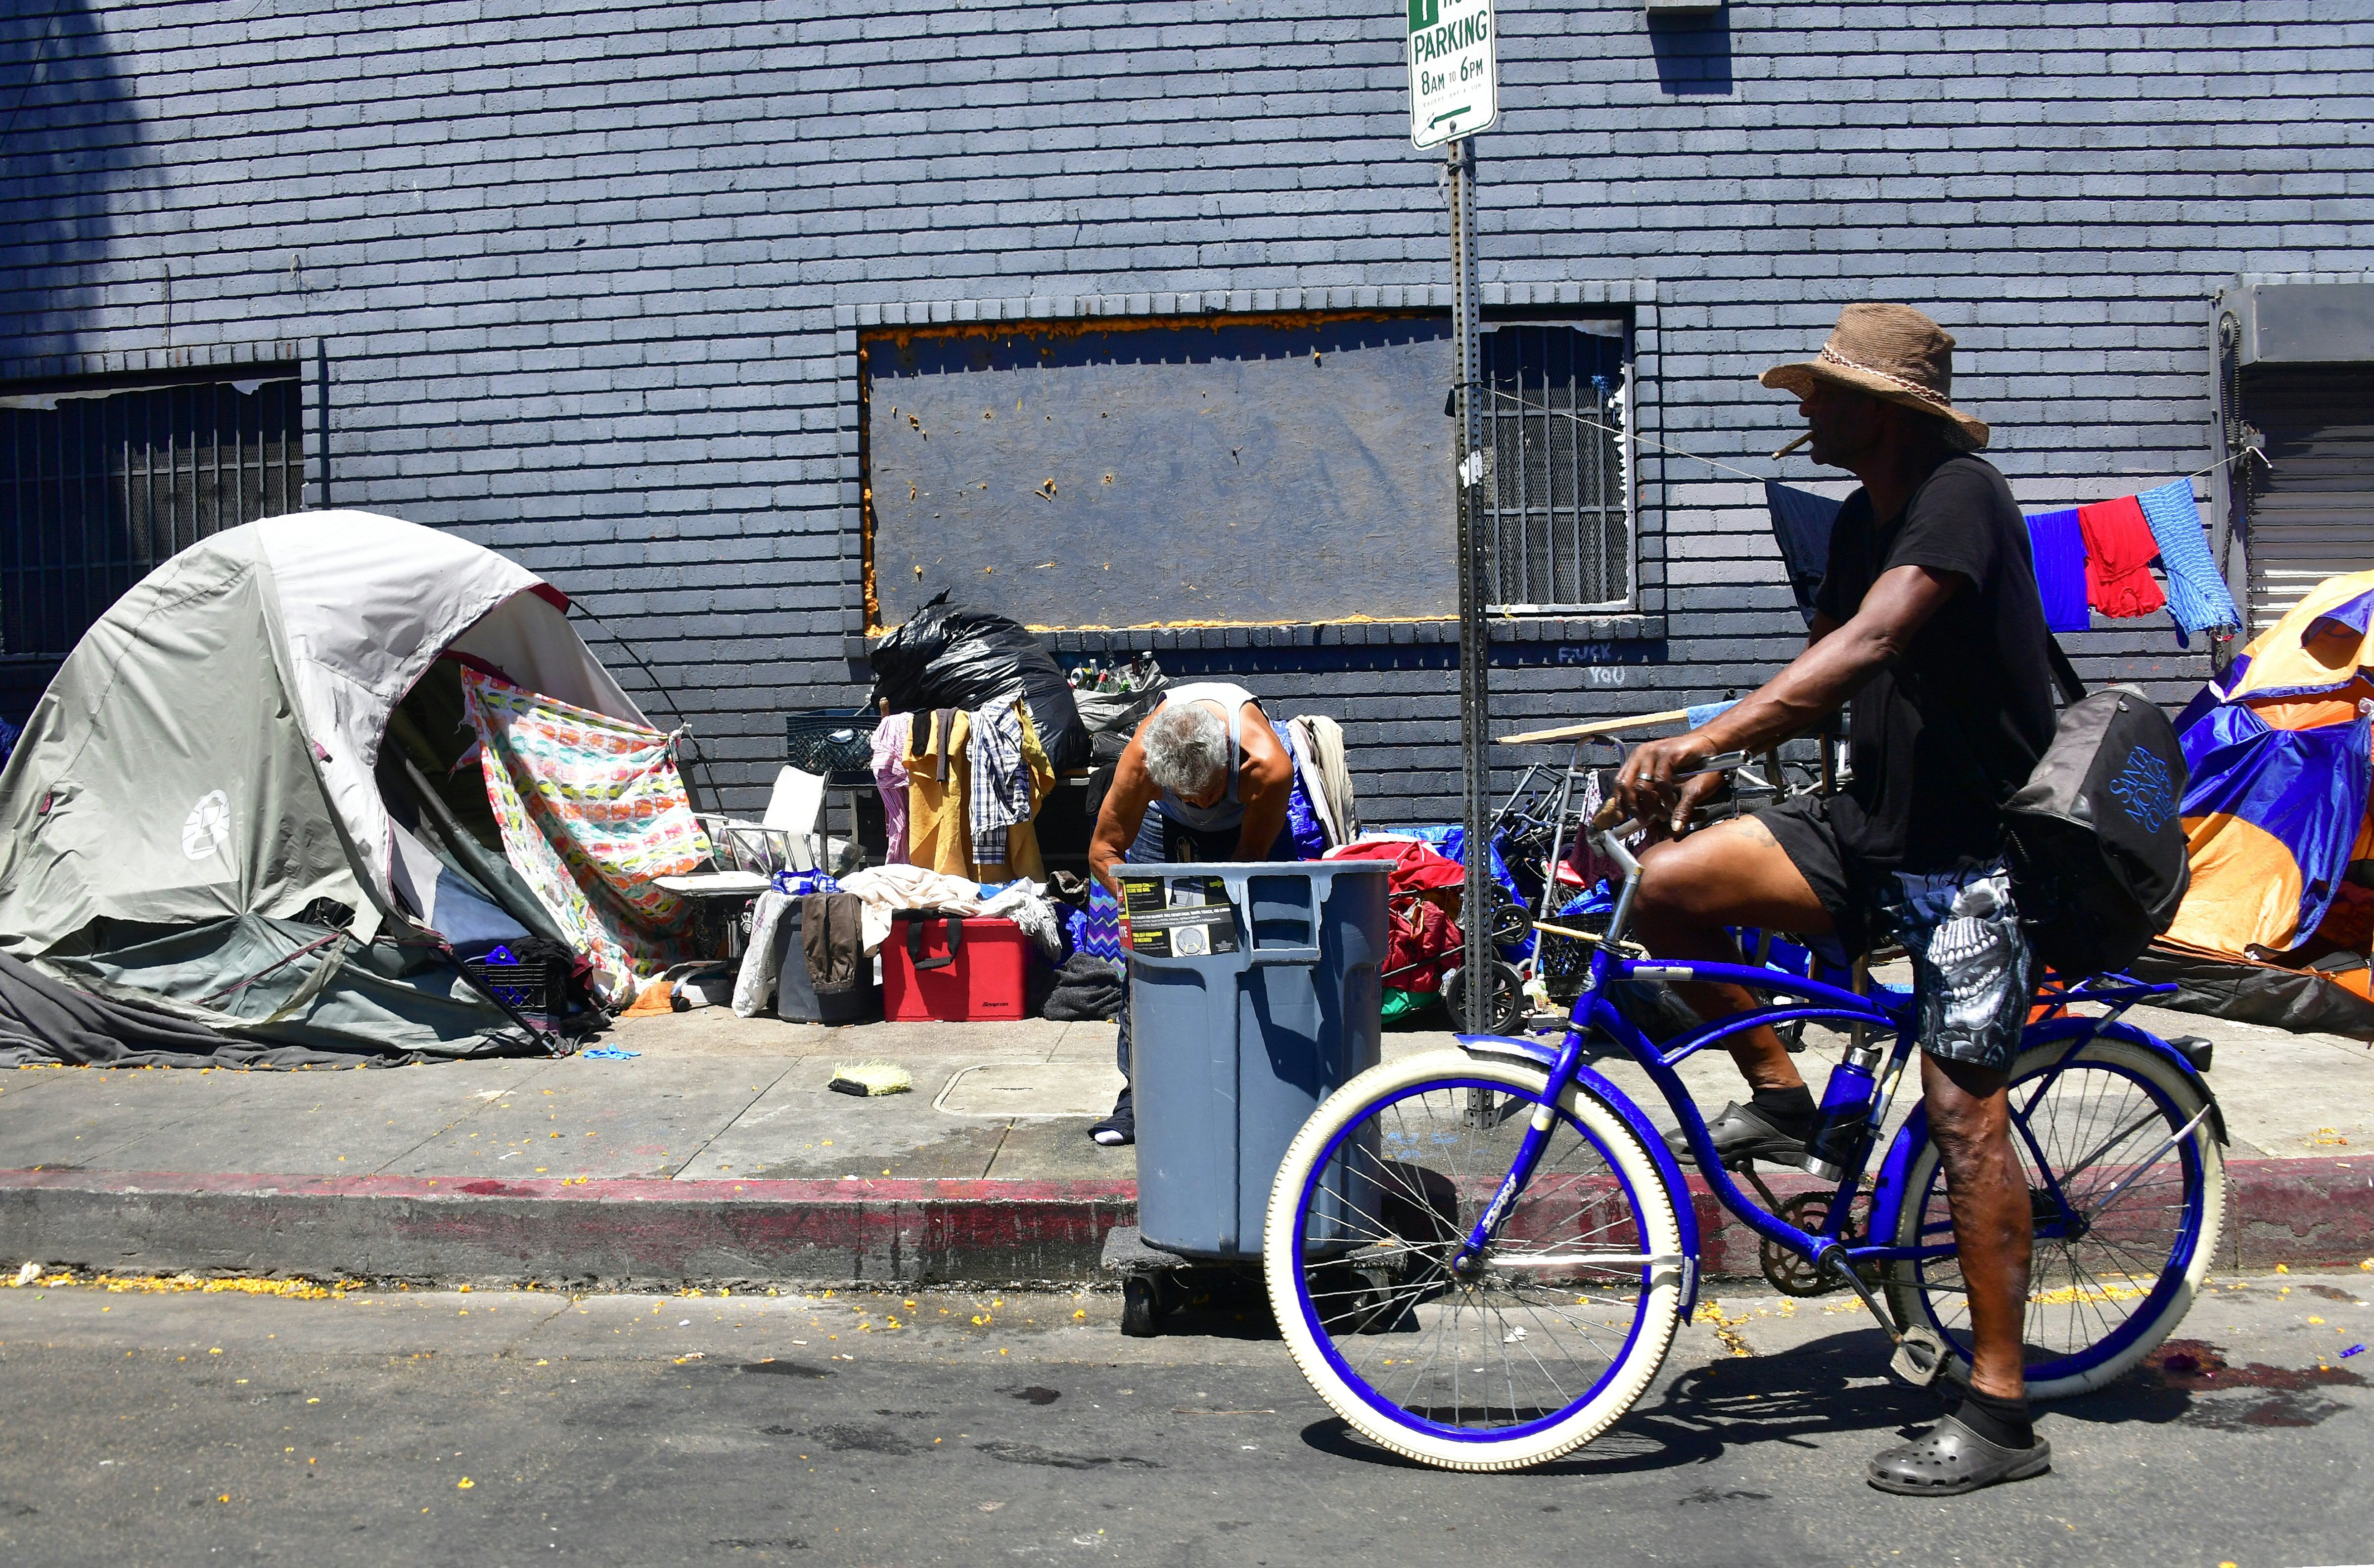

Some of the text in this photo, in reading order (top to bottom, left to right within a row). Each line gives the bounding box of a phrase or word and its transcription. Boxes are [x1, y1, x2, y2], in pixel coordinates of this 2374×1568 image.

[1415, 10, 1487, 65] PARKING
[1421, 56, 1483, 95] 8AM TO 6PM
[1423, 96, 1444, 107] EXCEPT
[1558, 642, 1611, 664] FUCK
[1590, 666, 1626, 685] YOU
[2110, 745, 2150, 804] SANTA
[2125, 757, 2167, 823] MONICA
